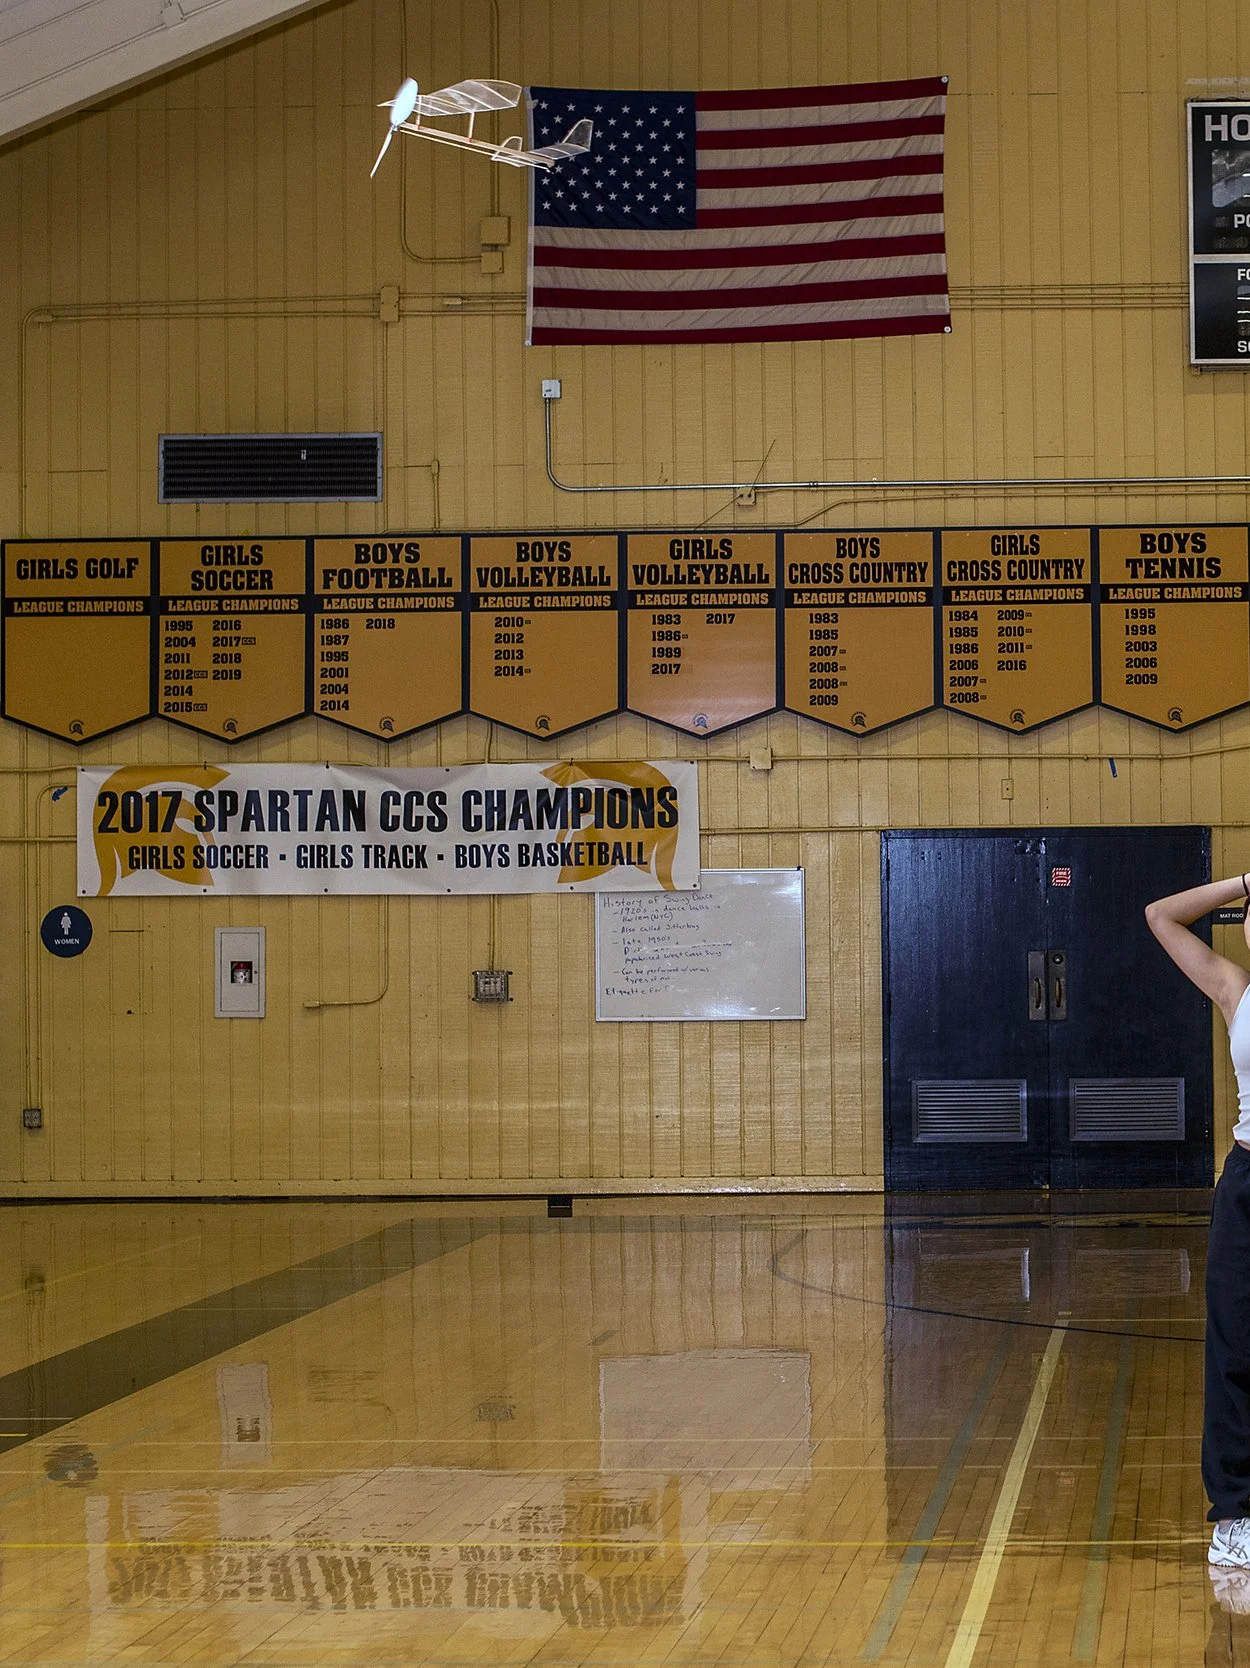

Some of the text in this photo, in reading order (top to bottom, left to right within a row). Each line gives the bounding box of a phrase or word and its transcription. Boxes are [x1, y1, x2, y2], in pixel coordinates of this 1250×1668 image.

[669, 539, 733, 560] GIRLS
[836, 538, 881, 559] BOYS
[991, 534, 1040, 556] GIRLS
[1140, 533, 1207, 554] BOYS
[201, 545, 264, 566] GIRLS
[354, 543, 420, 564] BOYS
[516, 541, 572, 563] BOYS
[16, 557, 139, 580] GIRLS GOLF
[633, 564, 770, 585] VOLLEYBALL
[788, 562, 928, 584] CROSS COUNTRY
[947, 558, 1085, 582] CROSS COUNTRY
[1125, 557, 1222, 579] TENNIS
[191, 570, 274, 591] SOCCER
[323, 568, 452, 589] FOOTBALL
[476, 566, 611, 588] VOLLEYBALL
[636, 593, 769, 606] LEAGUE CHAMPIONS
[793, 591, 926, 604] LEAGUE CHAMPIONS
[951, 588, 1084, 602] LEAGUE CHAMPIONS
[1109, 587, 1242, 600] LEAGUE CHAMPIONS
[13, 600, 144, 614] LEAGUE CHAMPIONS
[168, 599, 299, 612] LEAGUE CHAMPIONS
[323, 596, 455, 610] LEAGUE CHAMPIONS
[479, 595, 611, 609] LEAGUE CHAMPIONS
[651, 614, 681, 625] 1983
[706, 614, 736, 625] 2017
[809, 613, 839, 624] 1983
[949, 610, 978, 622] 1984
[1125, 608, 1156, 620] 1995
[164, 620, 193, 631] 1995
[212, 620, 242, 631] 2016
[320, 619, 350, 630] 1986
[365, 619, 396, 630] 2018
[320, 635, 350, 646] 1987
[494, 633, 524, 644] 2012
[809, 629, 839, 640] 1985
[164, 636, 196, 648] 2004
[1125, 641, 1157, 652] 2003
[212, 653, 242, 664] 2018
[494, 649, 524, 661] 2013
[997, 660, 1027, 671] 2016
[97, 786, 678, 833] 2017 SPARTAN CCS CHAMPIONS
[128, 841, 648, 870] GIRLS SOCCER GIRLS TRACK BOYS BASKETBALL
[603, 897, 642, 909] History
[649, 896, 660, 904] of
[663, 894, 690, 905] Swing
